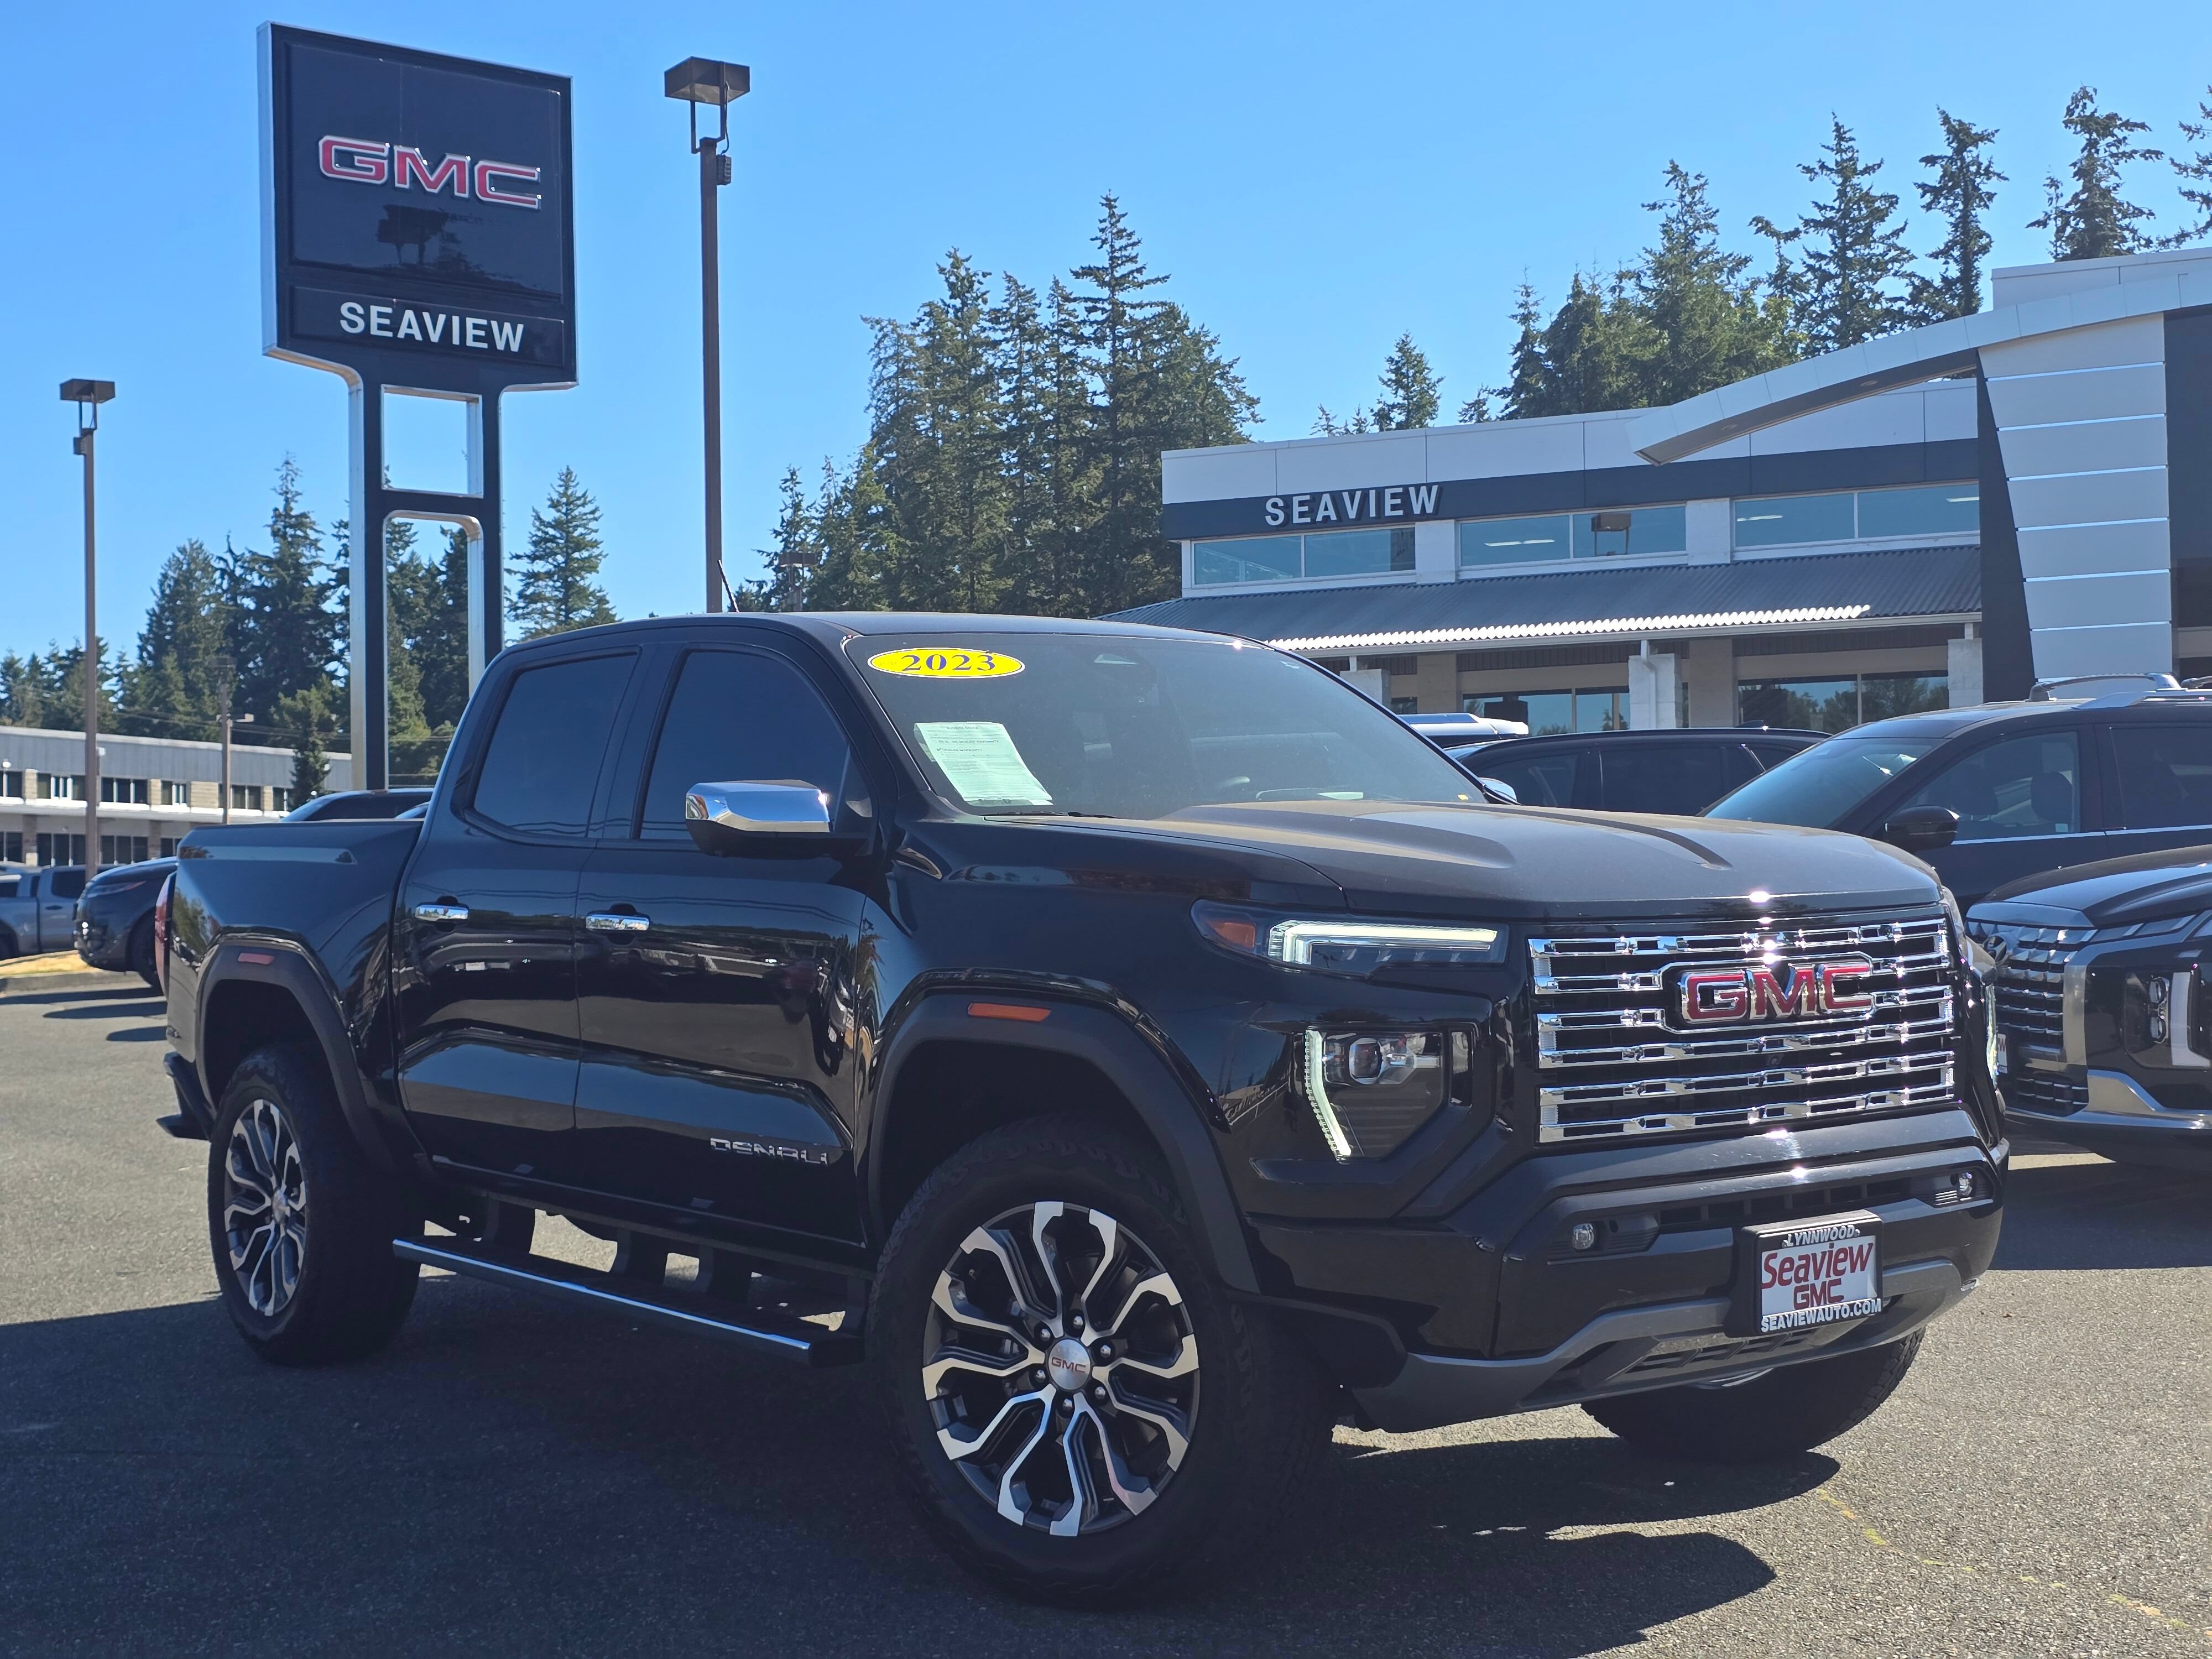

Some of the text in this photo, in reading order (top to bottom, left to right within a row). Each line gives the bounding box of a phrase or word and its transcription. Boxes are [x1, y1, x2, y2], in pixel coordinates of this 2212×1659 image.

[319, 135, 541, 210] GMC
[340, 302, 524, 352] SEAVIEW
[1265, 484, 1439, 526] SEAVIEW
[901, 654, 995, 671] 2023
[1682, 963, 1872, 1023] GMC
[710, 1138, 828, 1166] DENALI
[1787, 1224, 1855, 1247] LYNNWOOD
[1761, 1243, 1874, 1289] Seaview
[1793, 1278, 1844, 1311] GMC
[1761, 1298, 1881, 1333] SEAVIEWAUTO.COM
[1051, 1357, 1086, 1373] GMC
